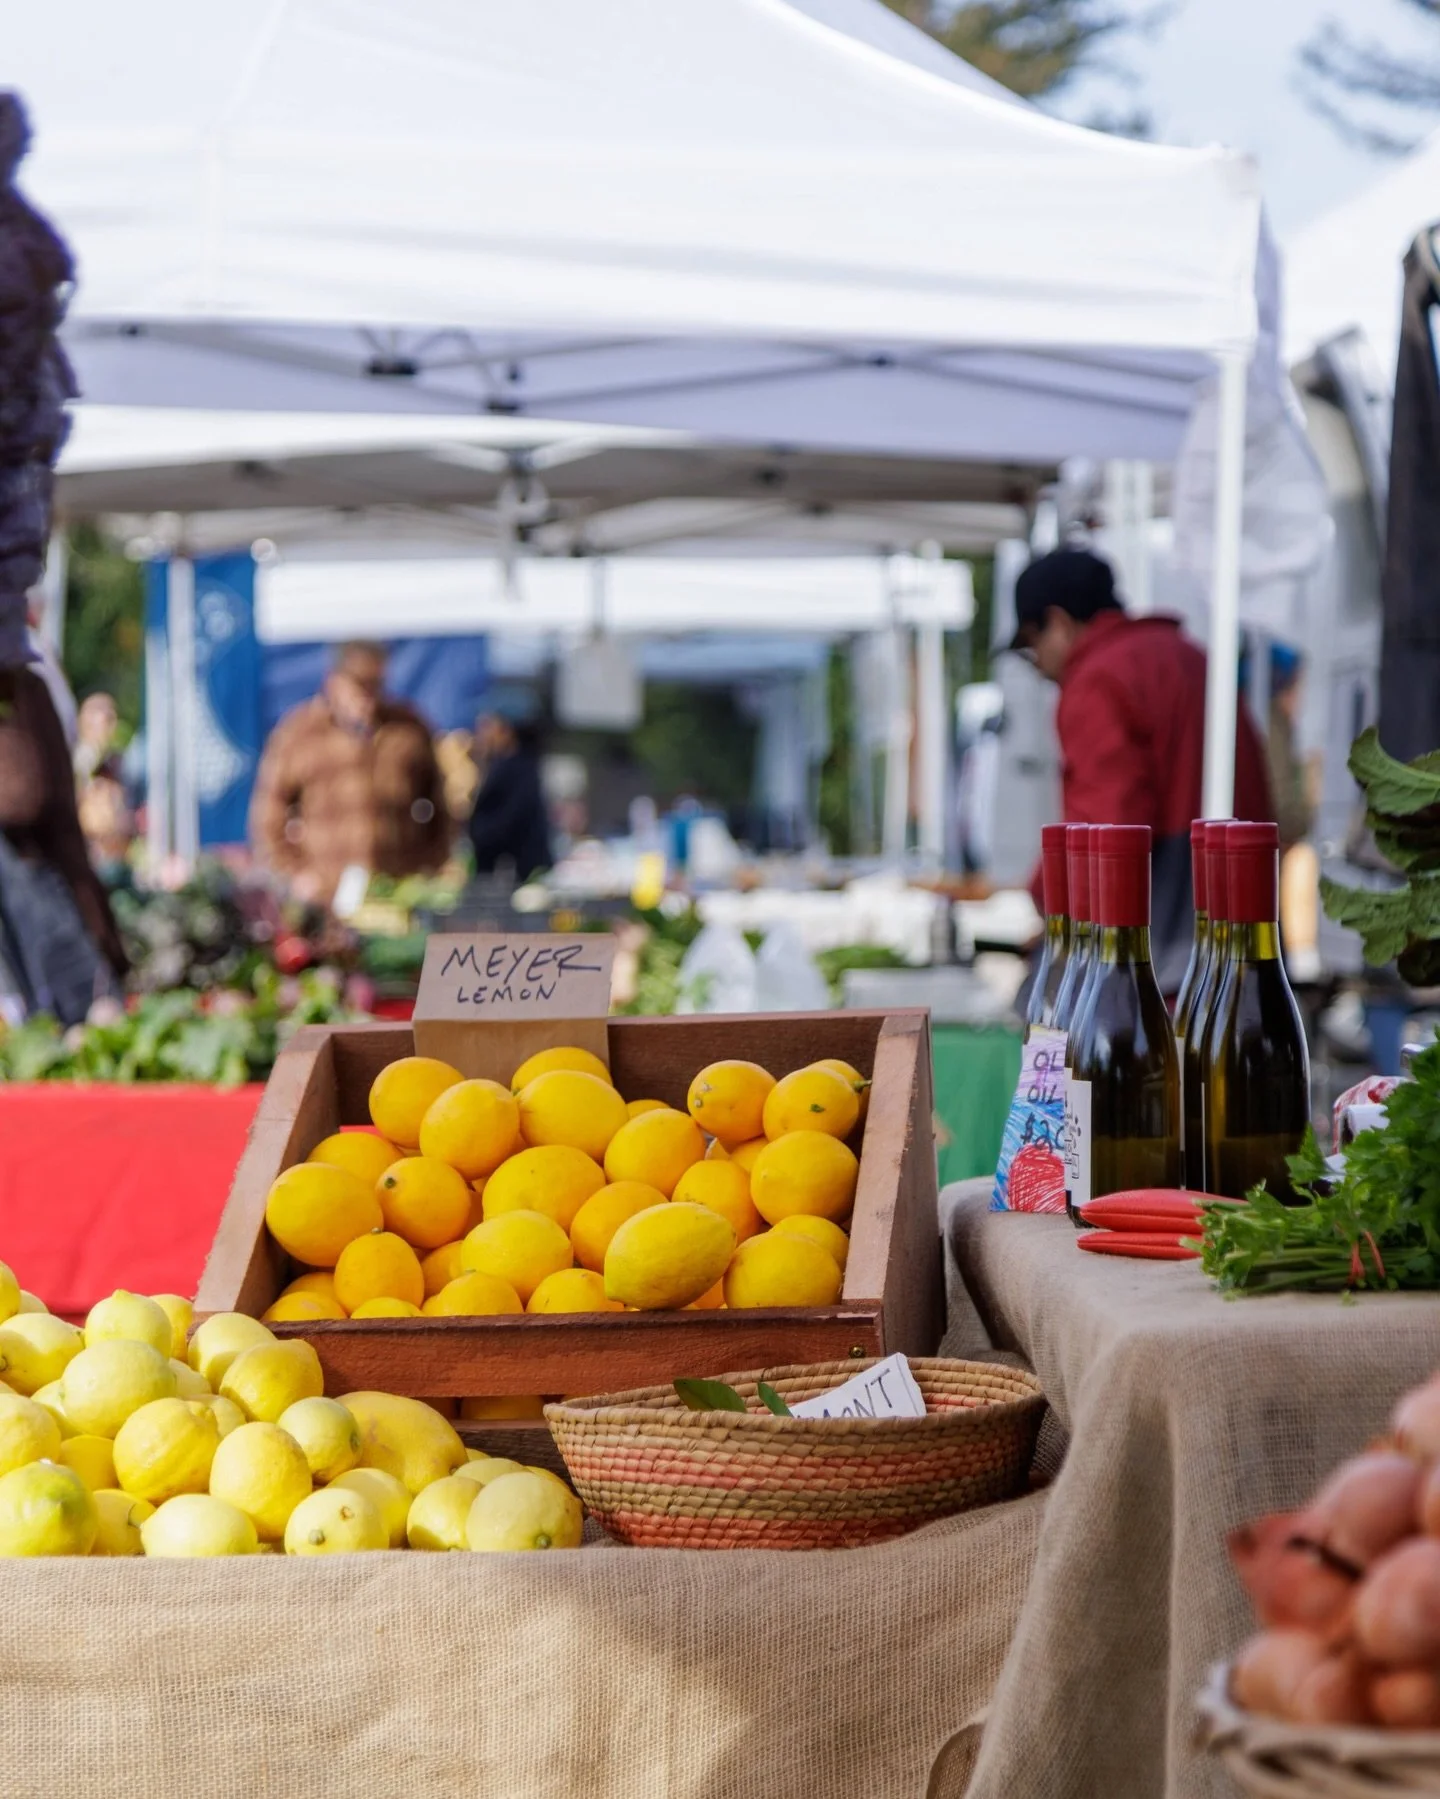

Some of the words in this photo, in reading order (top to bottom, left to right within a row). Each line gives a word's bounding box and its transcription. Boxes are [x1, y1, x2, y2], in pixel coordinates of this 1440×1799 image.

[441, 945, 601, 984] MEYER
[457, 982, 556, 1004] LEMON
[1033, 1050, 1064, 1071] OL
[1027, 1084, 1064, 1104] OIL
